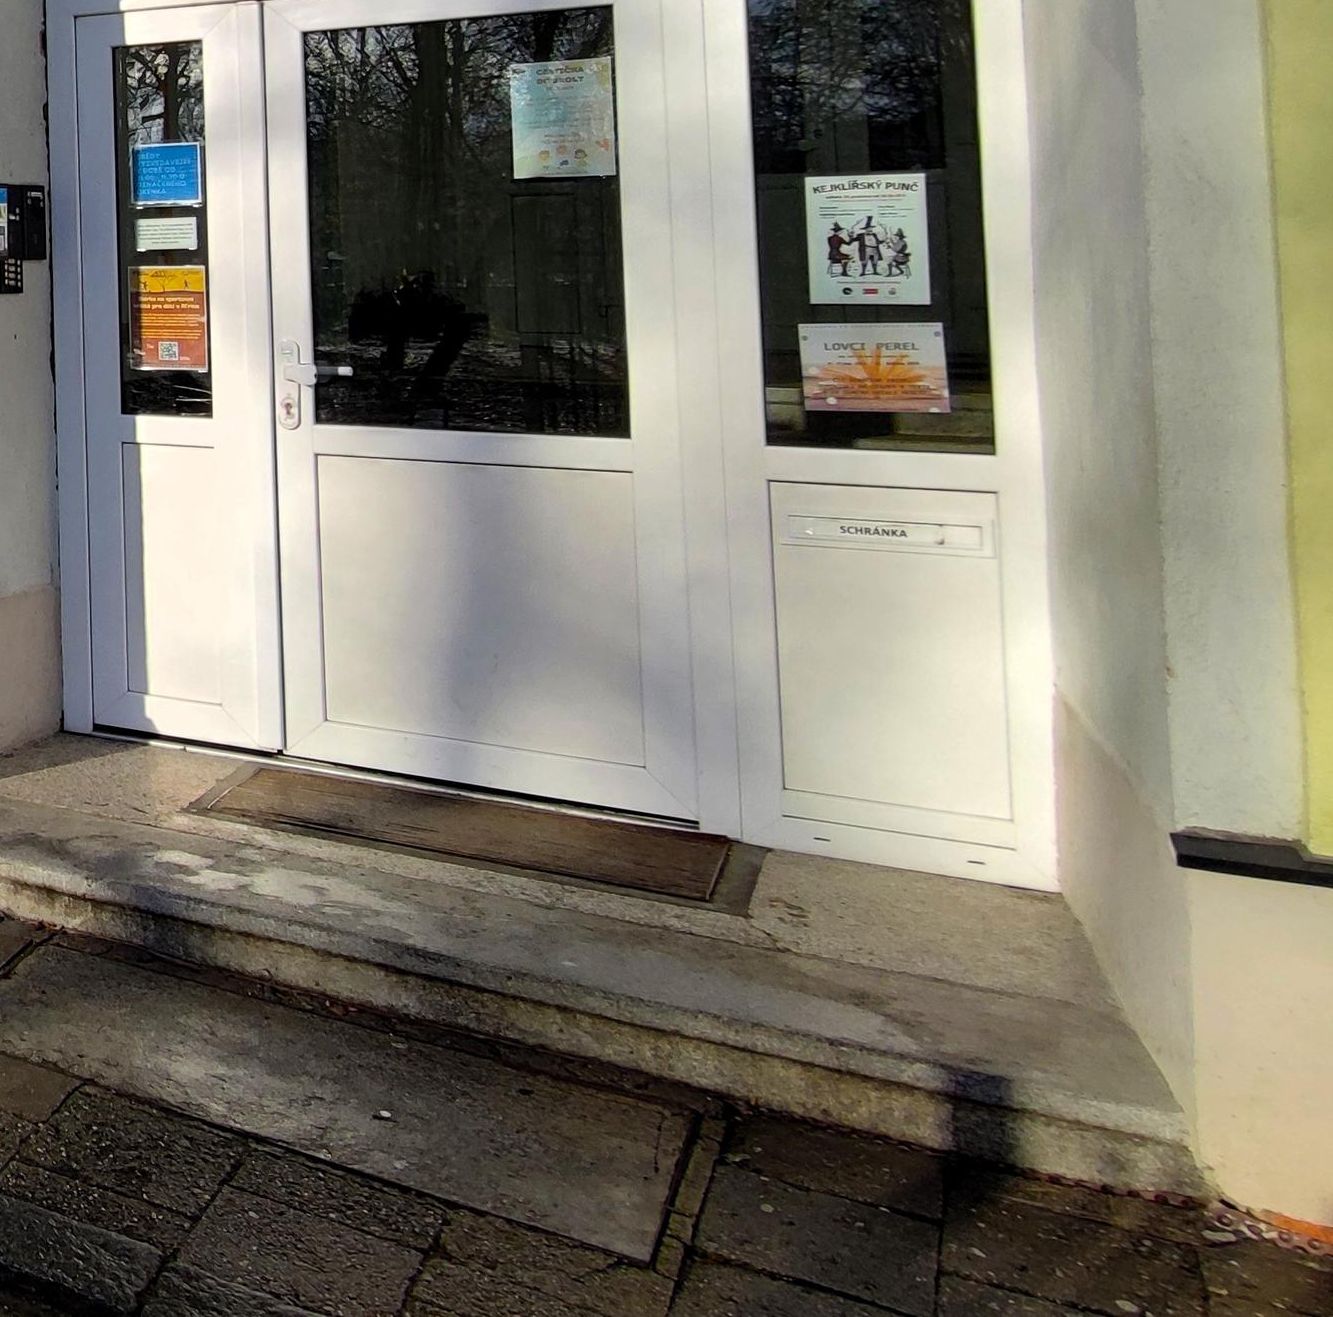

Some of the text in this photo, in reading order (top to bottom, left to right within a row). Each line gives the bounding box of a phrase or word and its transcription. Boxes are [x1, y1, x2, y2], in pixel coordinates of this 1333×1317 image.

[813, 179, 919, 194] KEJKLÍŘSKÝ PUNČ
[824, 342, 920, 351] LOVCI PEREL
[839, 525, 908, 538] SCHRÁNKA
